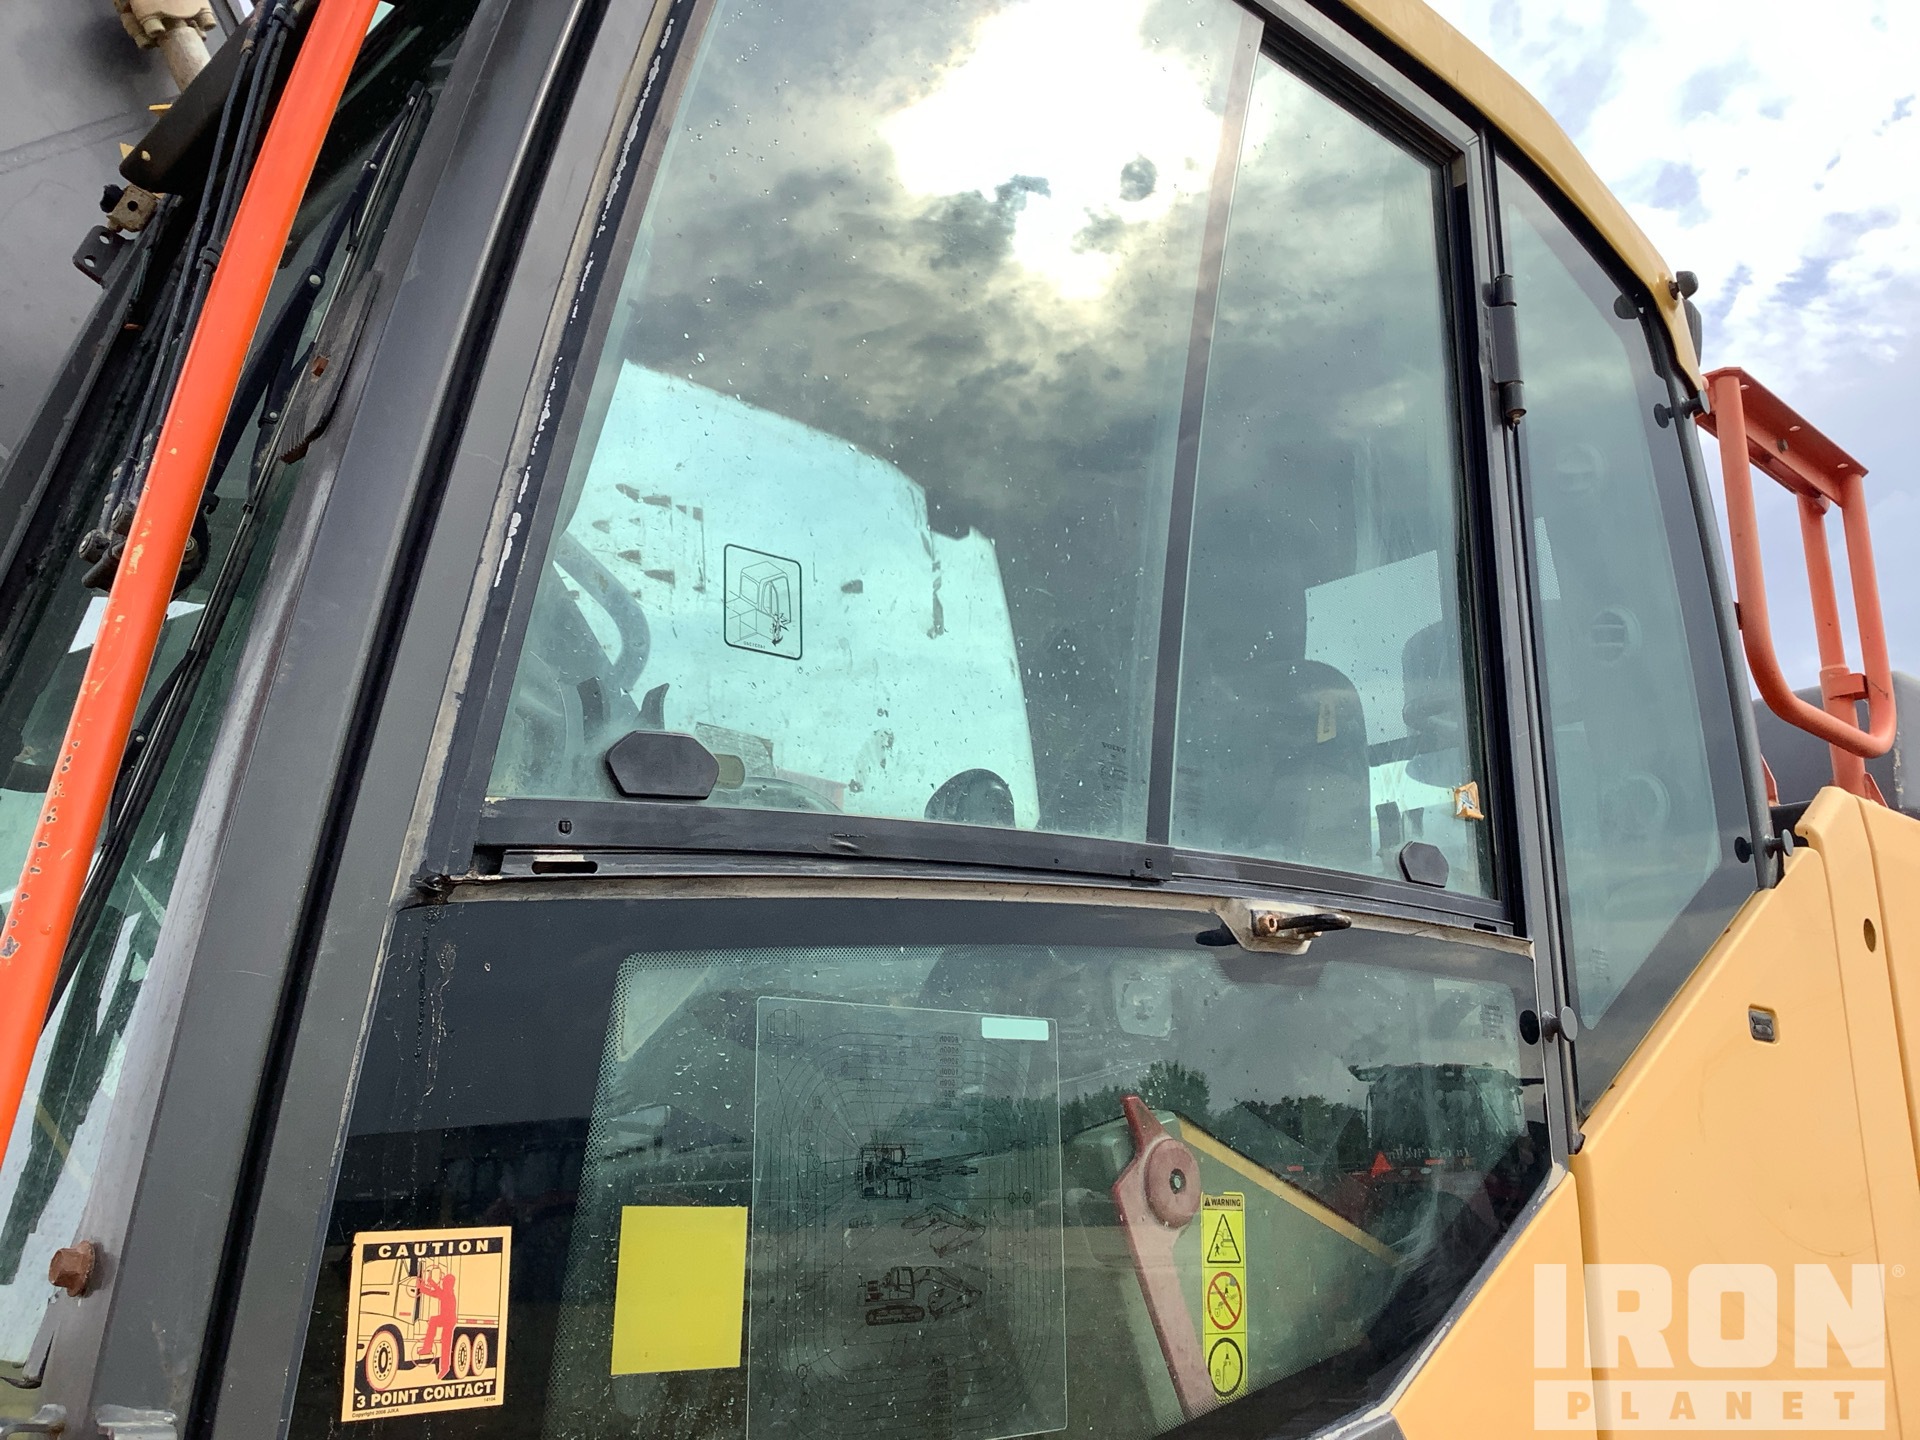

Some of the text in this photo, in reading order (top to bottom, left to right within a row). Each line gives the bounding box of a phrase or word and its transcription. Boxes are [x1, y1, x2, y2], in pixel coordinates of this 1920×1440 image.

[1101, 741, 1127, 754] VOLVO
[1211, 1198, 1241, 1207] WARNING
[378, 1239, 489, 1258] CAUTION
[356, 1380, 494, 1409] 3 POINT CONTACT
[351, 1410, 375, 1418] Copyright
